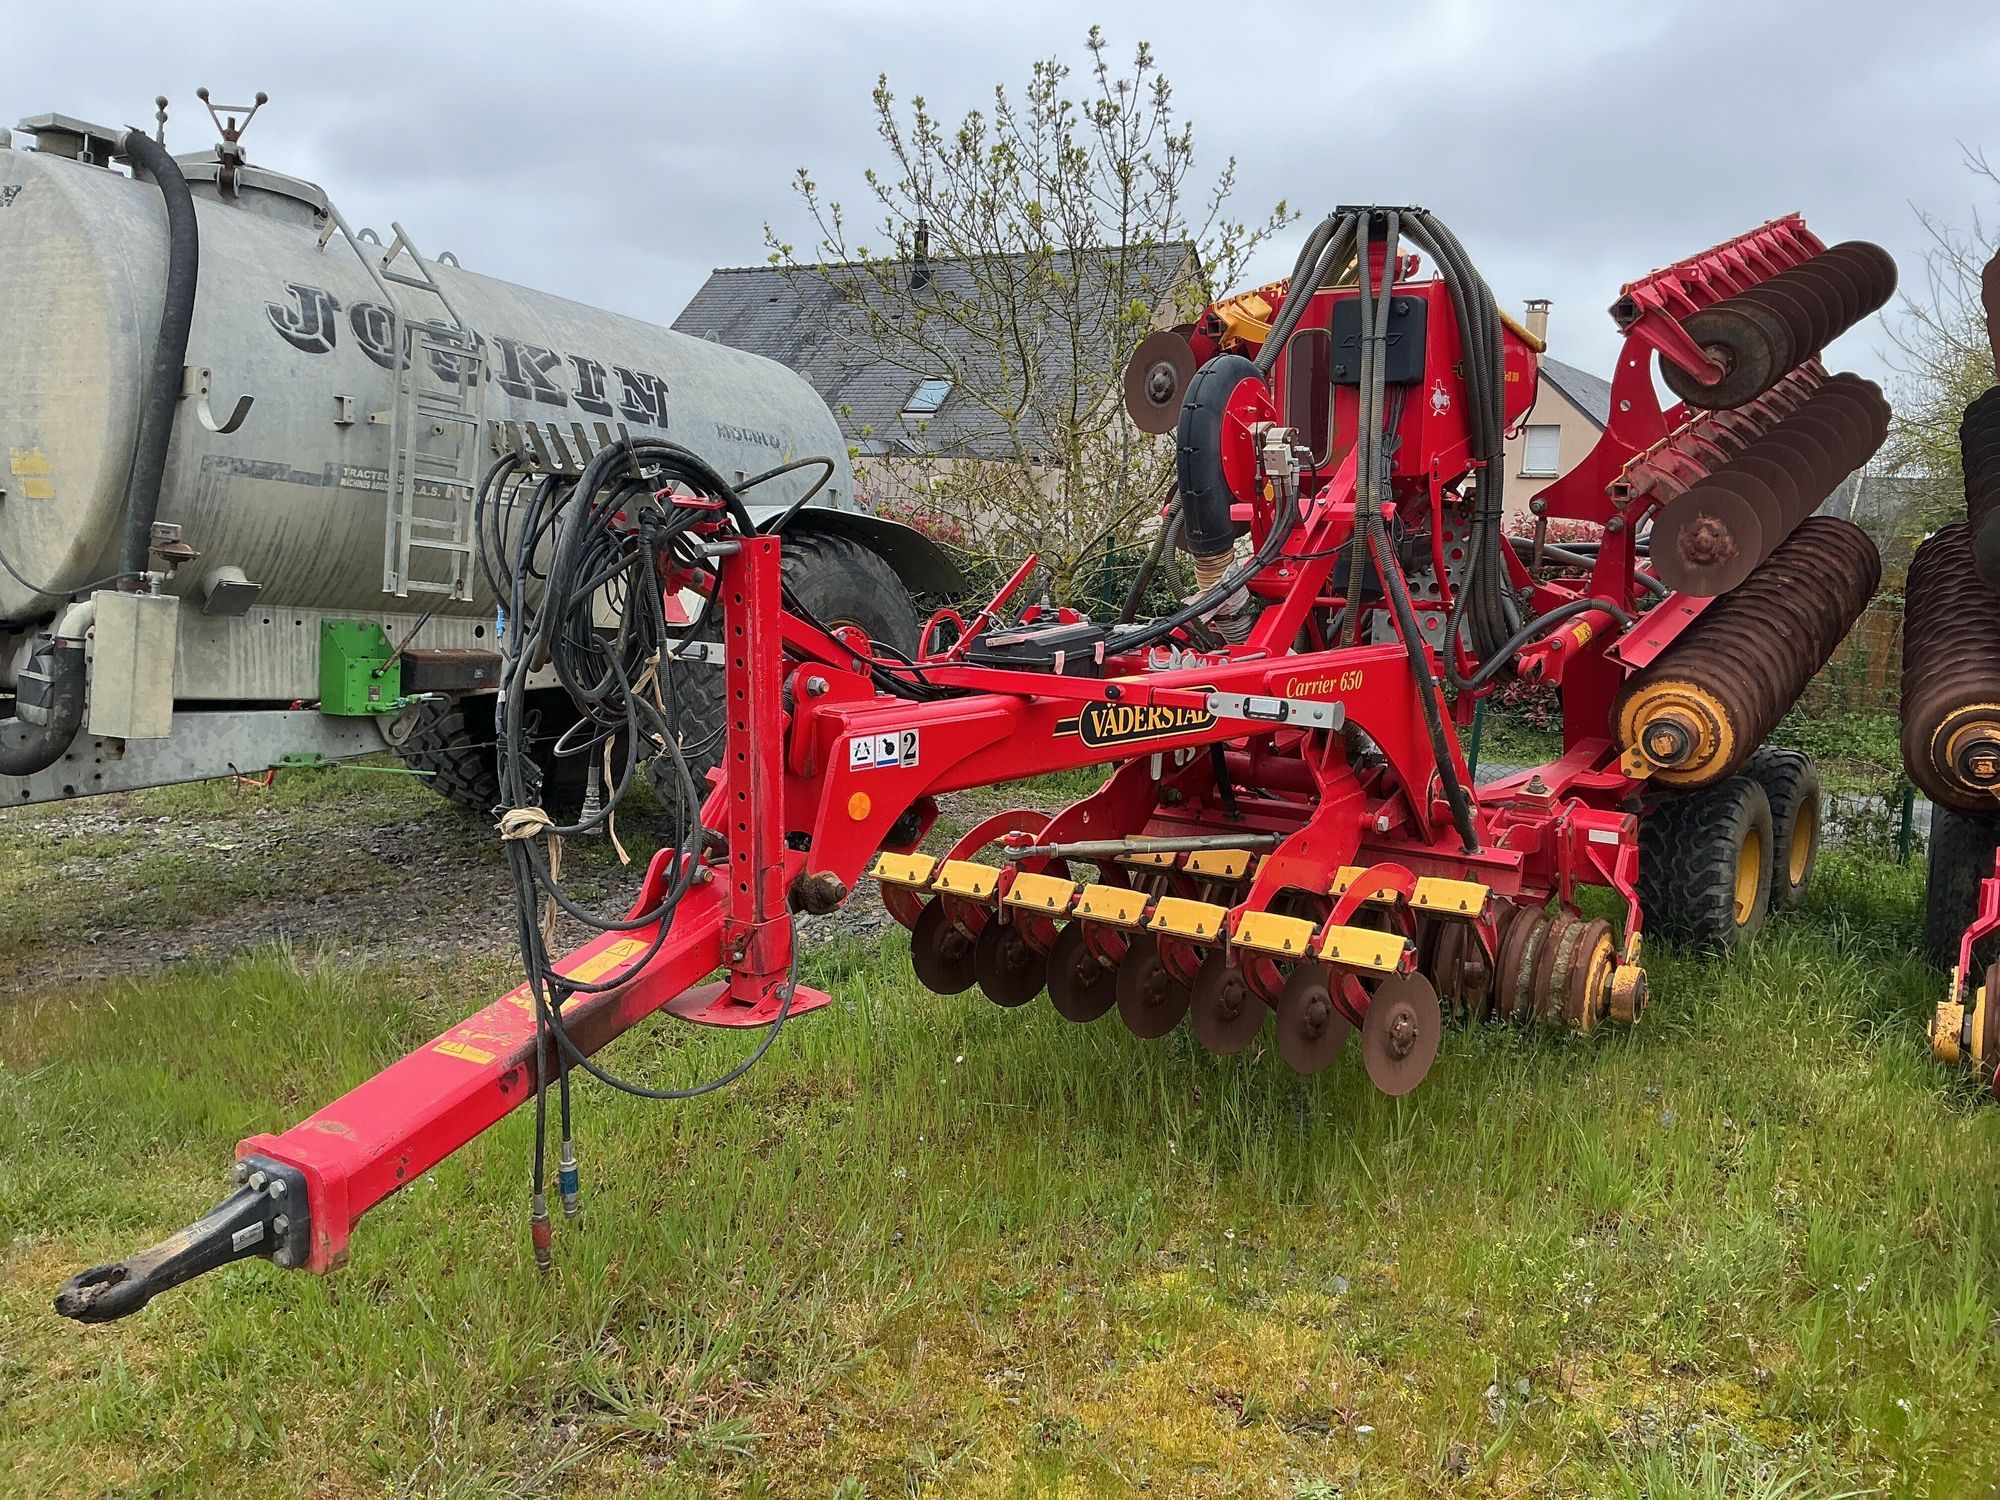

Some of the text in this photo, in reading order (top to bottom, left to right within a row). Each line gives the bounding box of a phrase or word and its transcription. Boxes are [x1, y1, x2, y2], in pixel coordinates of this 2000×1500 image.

[264, 280, 670, 429] JOSKIN
[343, 467, 406, 483] TRACTEUS
[1286, 670, 1363, 699] Carrier 650
[903, 732, 917, 760] 2
